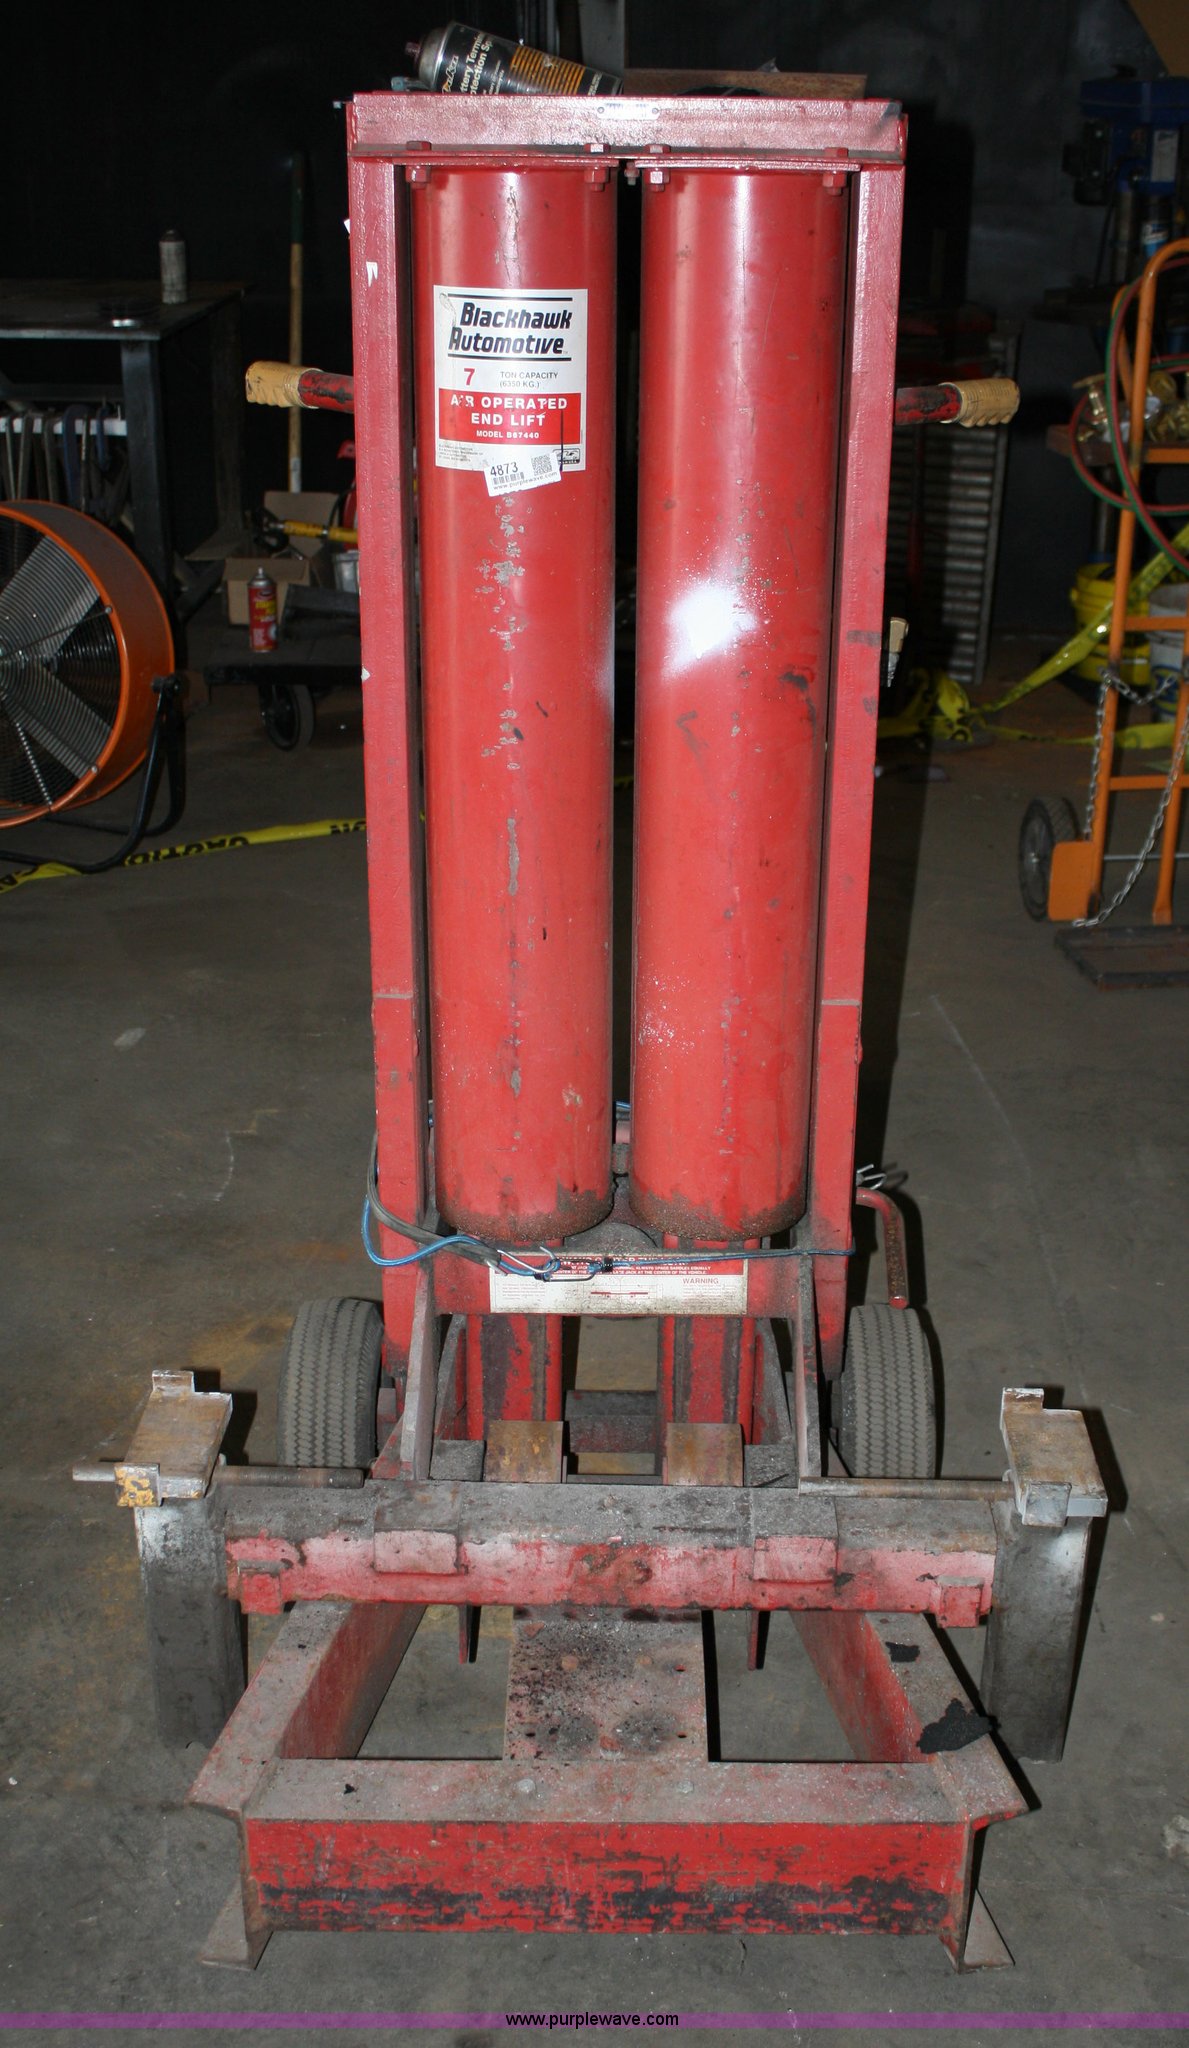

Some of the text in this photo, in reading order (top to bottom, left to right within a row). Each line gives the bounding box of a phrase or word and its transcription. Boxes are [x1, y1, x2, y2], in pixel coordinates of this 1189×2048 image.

[460, 65, 474, 92] ttery
[471, 52, 487, 95] otection
[460, 301, 573, 329] Blackhawk
[448, 327, 564, 354] Automotive
[463, 367, 475, 386] 7
[499, 380, 540, 389] (6350 KG.)
[500, 371, 559, 379] TON CAPACITY
[450, 393, 567, 410] AR OPERATED
[471, 412, 546, 427] END LIFT
[476, 430, 503, 438] MODEL
[490, 461, 519, 477] 4873
[493, 471, 558, 490] www.purplewave.com
[124, 836, 250, 868] CAUTIO
